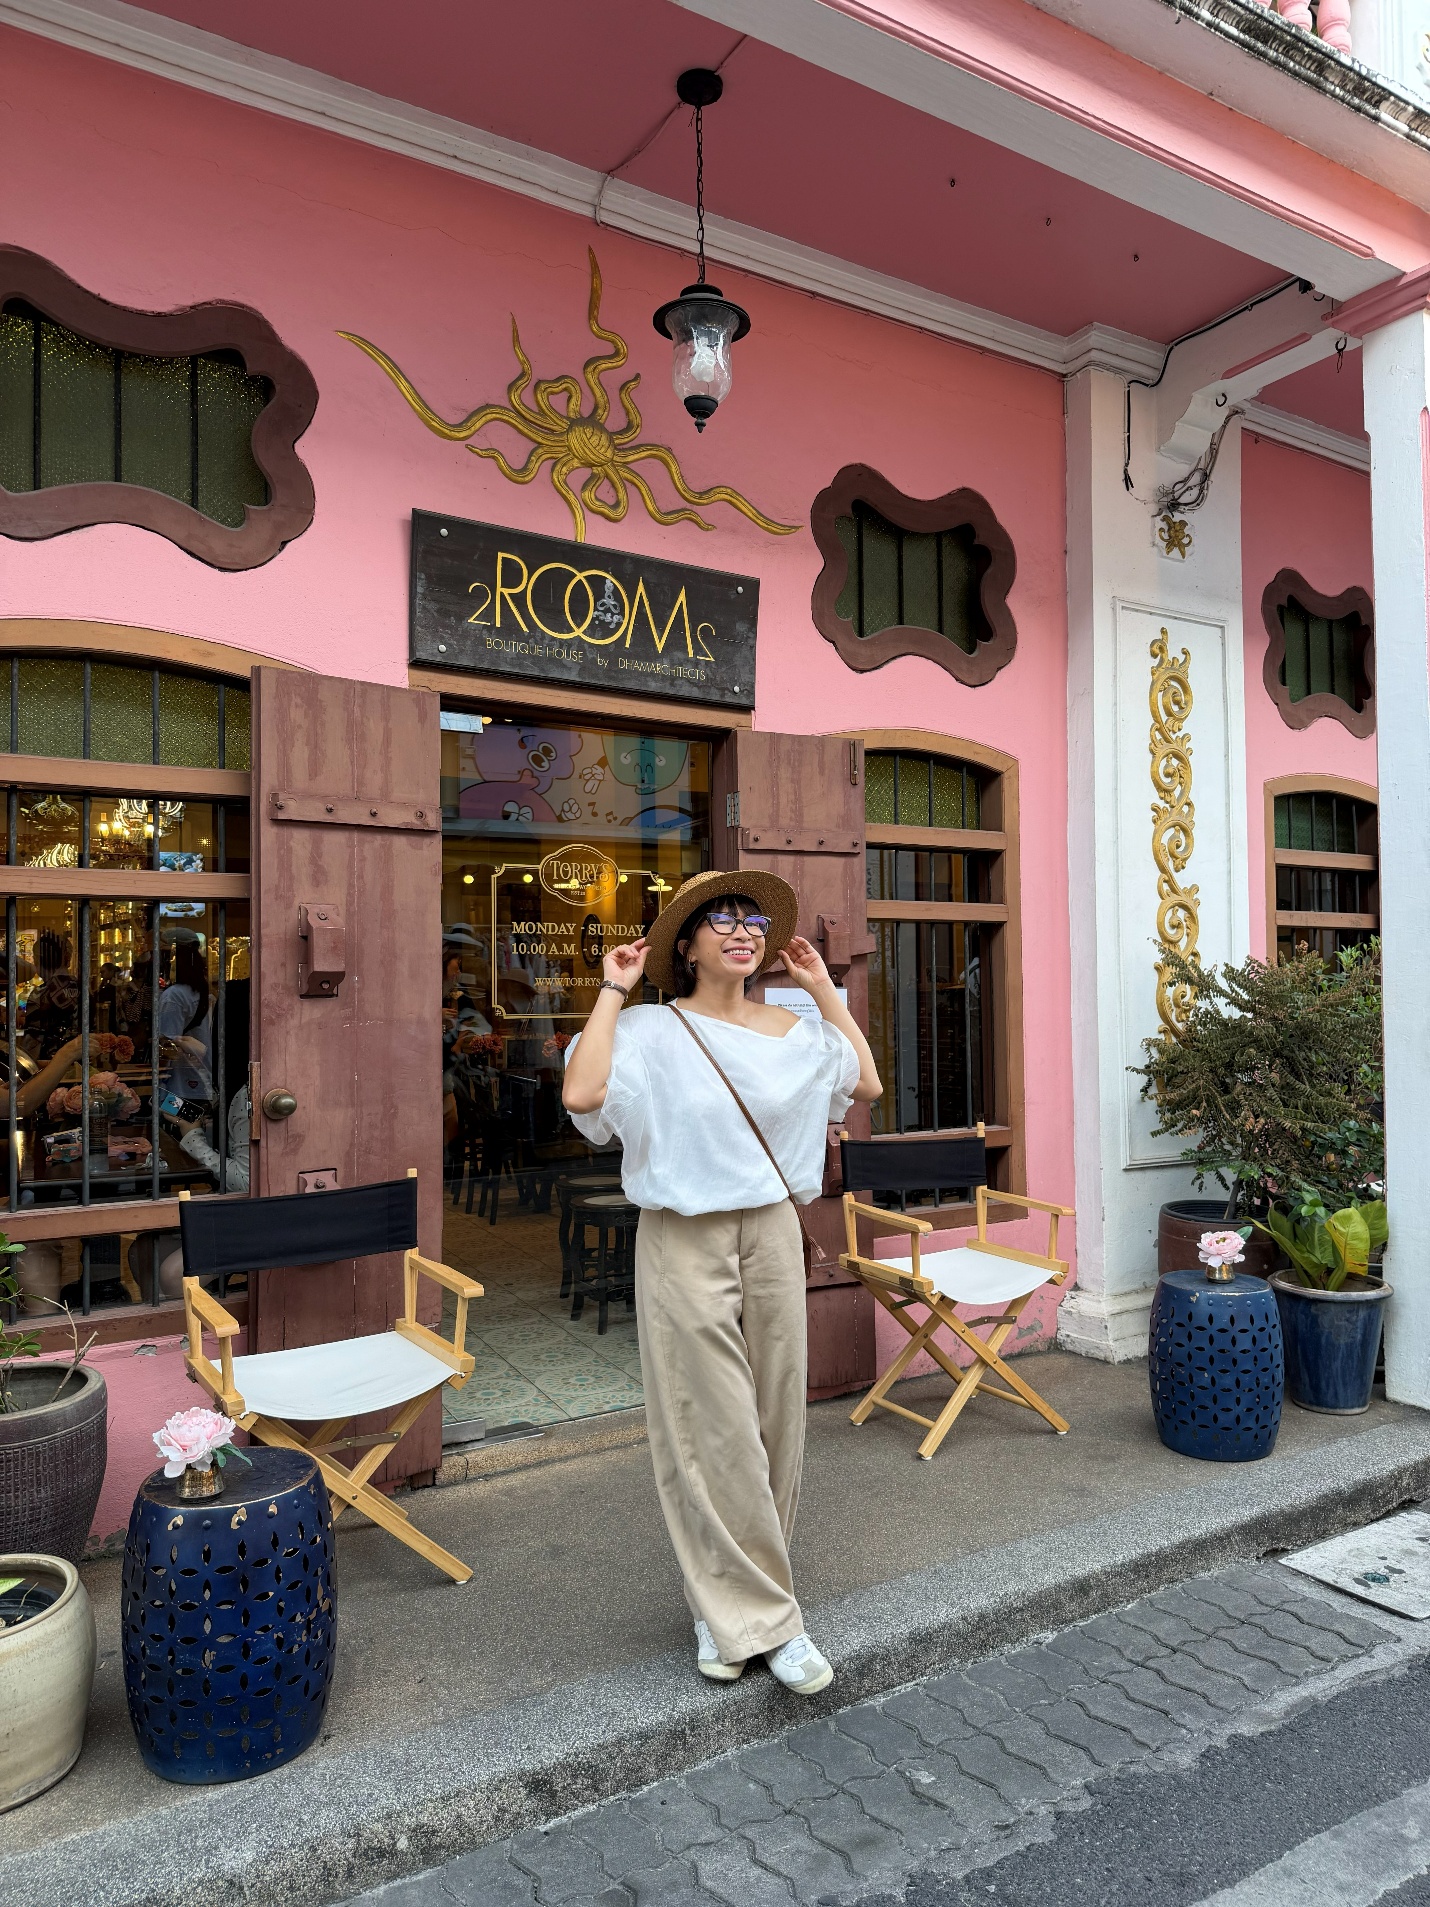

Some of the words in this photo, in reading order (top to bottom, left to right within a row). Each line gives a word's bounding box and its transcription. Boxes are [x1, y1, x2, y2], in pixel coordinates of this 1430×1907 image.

[486, 637, 543, 658] BOUTIQUE
[546, 647, 584, 663] HOUSE
[597, 653, 609, 669] by
[618, 657, 706, 681] DHAMARCHITECTS
[549, 860, 610, 883] TORRY'S
[512, 922, 576, 935] MONDAY
[588, 923, 646, 937] SUNDAY
[512, 943, 546, 954] 10.00
[548, 943, 579, 955] A.M.
